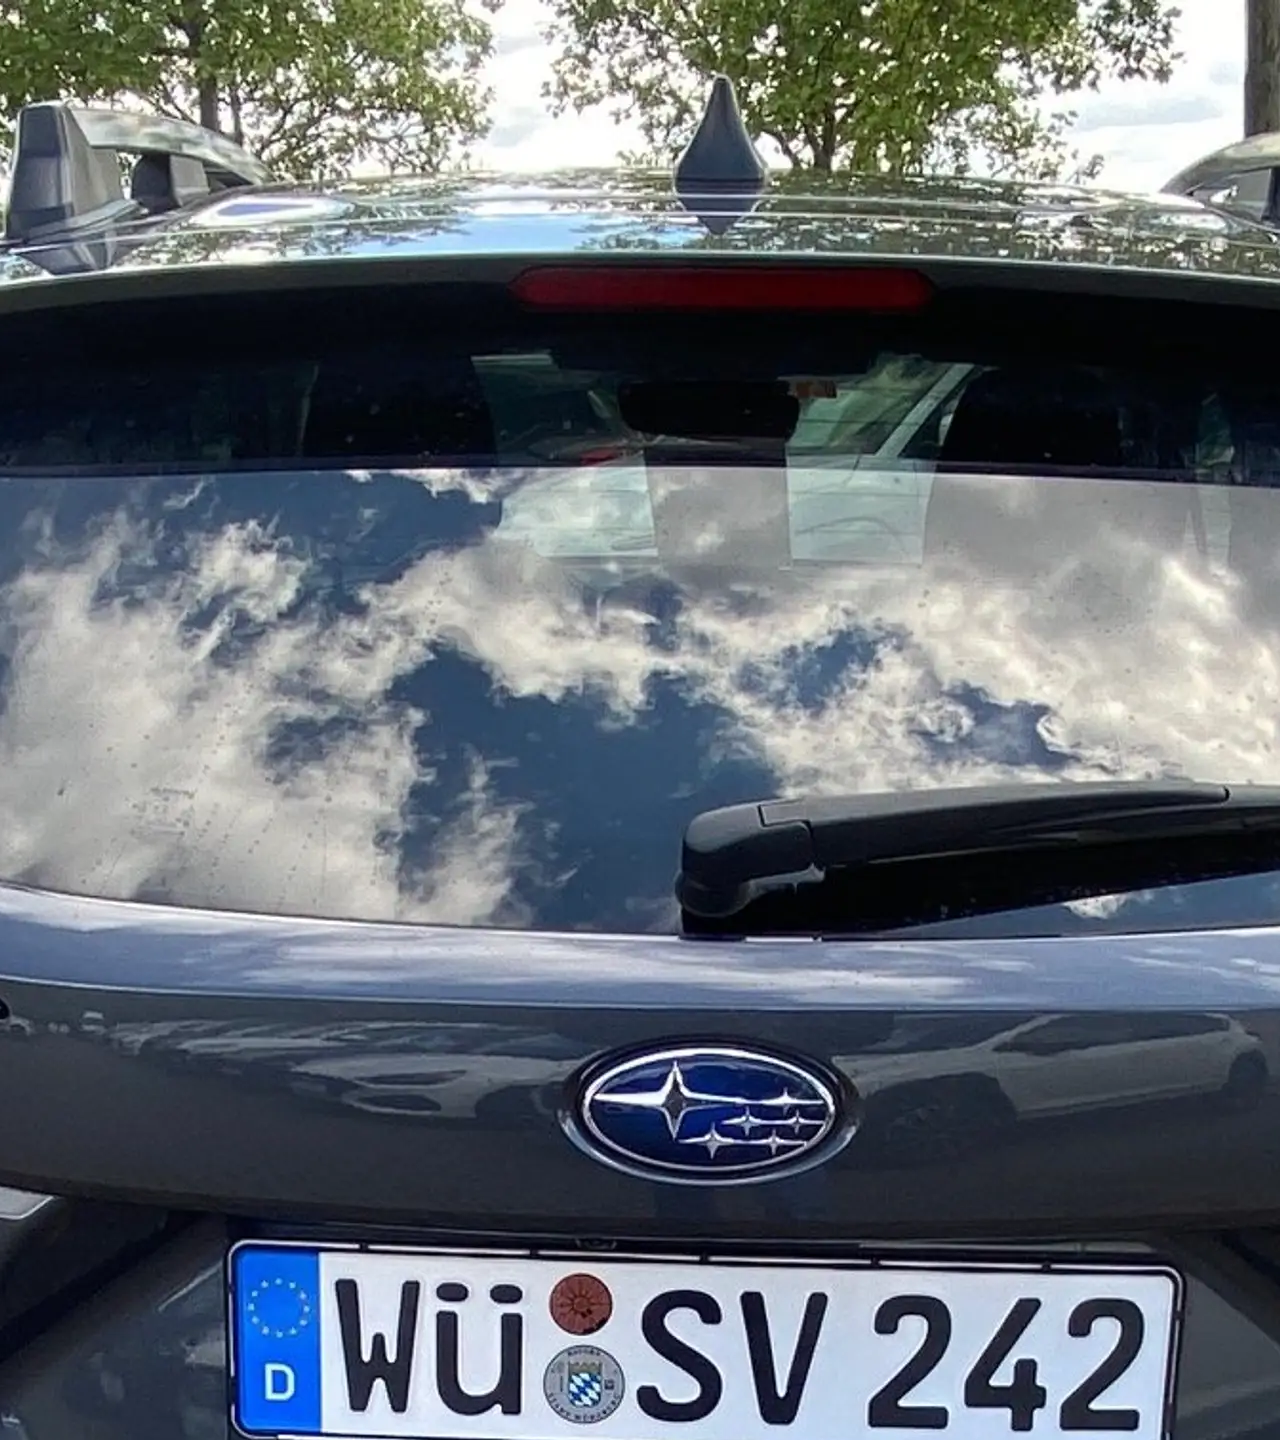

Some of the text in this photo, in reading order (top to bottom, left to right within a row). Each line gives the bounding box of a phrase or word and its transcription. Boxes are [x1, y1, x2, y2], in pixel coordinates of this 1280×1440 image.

[264, 1362, 296, 1401] D
[333, 1277, 1146, 1432] WÜ SV 242
